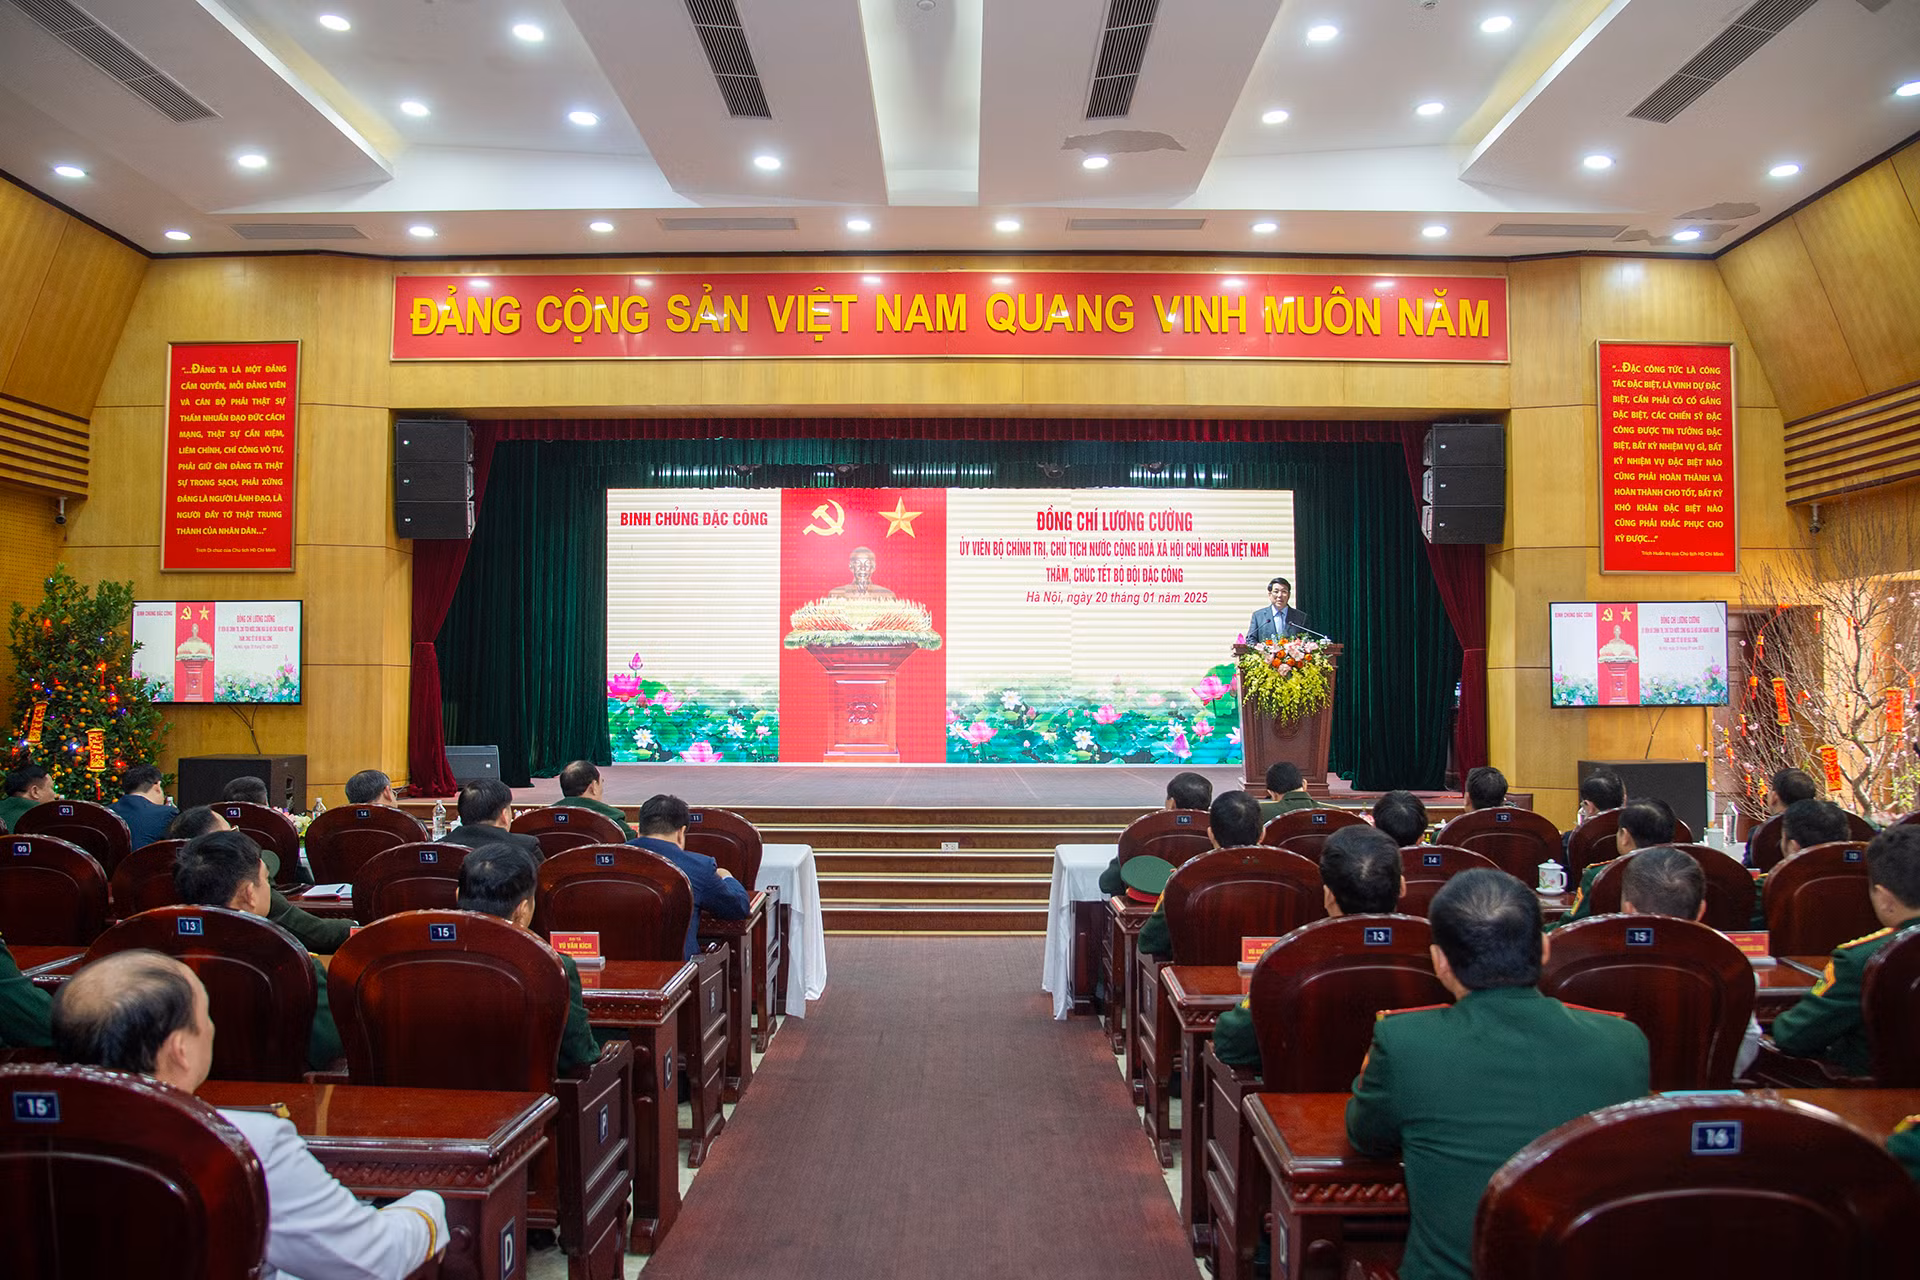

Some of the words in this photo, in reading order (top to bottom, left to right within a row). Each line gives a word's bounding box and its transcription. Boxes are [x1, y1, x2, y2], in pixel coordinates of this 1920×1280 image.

[410, 285, 521, 335] ĐẢNG
[536, 288, 649, 343] CỘNG
[666, 284, 748, 332] SẢN
[767, 286, 858, 342] VIỆT
[876, 293, 967, 332] NAM
[985, 292, 1134, 334] QUANG
[1153, 295, 1246, 333] VINH
[1264, 286, 1381, 335] MUÔN
[1398, 288, 1489, 337] NĂM
[1663, 380, 1672, 388] LÀ
[230, 414, 246, 423] ĐẠO
[199, 494, 208, 502] LÀ
[620, 512, 651, 526] BINH
[655, 506, 698, 526] CHỦNG
[703, 509, 728, 528] ĐẶC
[733, 509, 768, 526] CÔNG
[1036, 504, 1072, 531] ĐỒNG
[1077, 508, 1098, 531] CHÍ
[1102, 510, 1144, 531] LƯƠNG
[1149, 507, 1192, 531] CƯỜNG
[960, 536, 970, 556] ỦY
[972, 538, 990, 556] VIÊN
[993, 538, 1004, 559] BỘ
[1006, 538, 1031, 556] CHÍNH
[1050, 536, 1066, 556] CHỦ
[1069, 542, 1087, 559] TỊCH
[1090, 538, 1111, 556] NƯỚC
[1114, 539, 1136, 559] CỘNG
[1157, 539, 1168, 556] XÃ
[1170, 539, 1183, 560] HỘI
[1186, 537, 1202, 556] CHỦ
[1205, 539, 1229, 557] NGHĨA
[1232, 539, 1248, 560] VIỆT
[1250, 543, 1269, 557] NAM
[1046, 565, 1071, 584] THĂM,
[1074, 564, 1095, 582] CHÚC
[1098, 563, 1111, 582] TẾT
[1114, 565, 1124, 586] BỘ
[1127, 565, 1140, 586] ĐỘI
[1142, 565, 1158, 586] ĐẶC
[1162, 564, 1183, 582] CÔNG
[1026, 592, 1040, 602] Hà
[1044, 592, 1063, 605] Nội,
[1067, 592, 1092, 605] ngày
[1096, 592, 1108, 602] 20
[1111, 592, 1140, 606] tháng
[1143, 592, 1154, 602] 01
[1158, 592, 1180, 602] năm
[1184, 592, 1208, 603] 2025
[424, 853, 434, 861] 13
[185, 921, 196, 931] 13
[438, 927, 450, 937] 15
[1372, 931, 1385, 941] 13
[1634, 932, 1647, 942] 15
[26, 1098, 48, 1116] 15
[1705, 1128, 1729, 1148] 16
[504, 1233, 513, 1271] D
